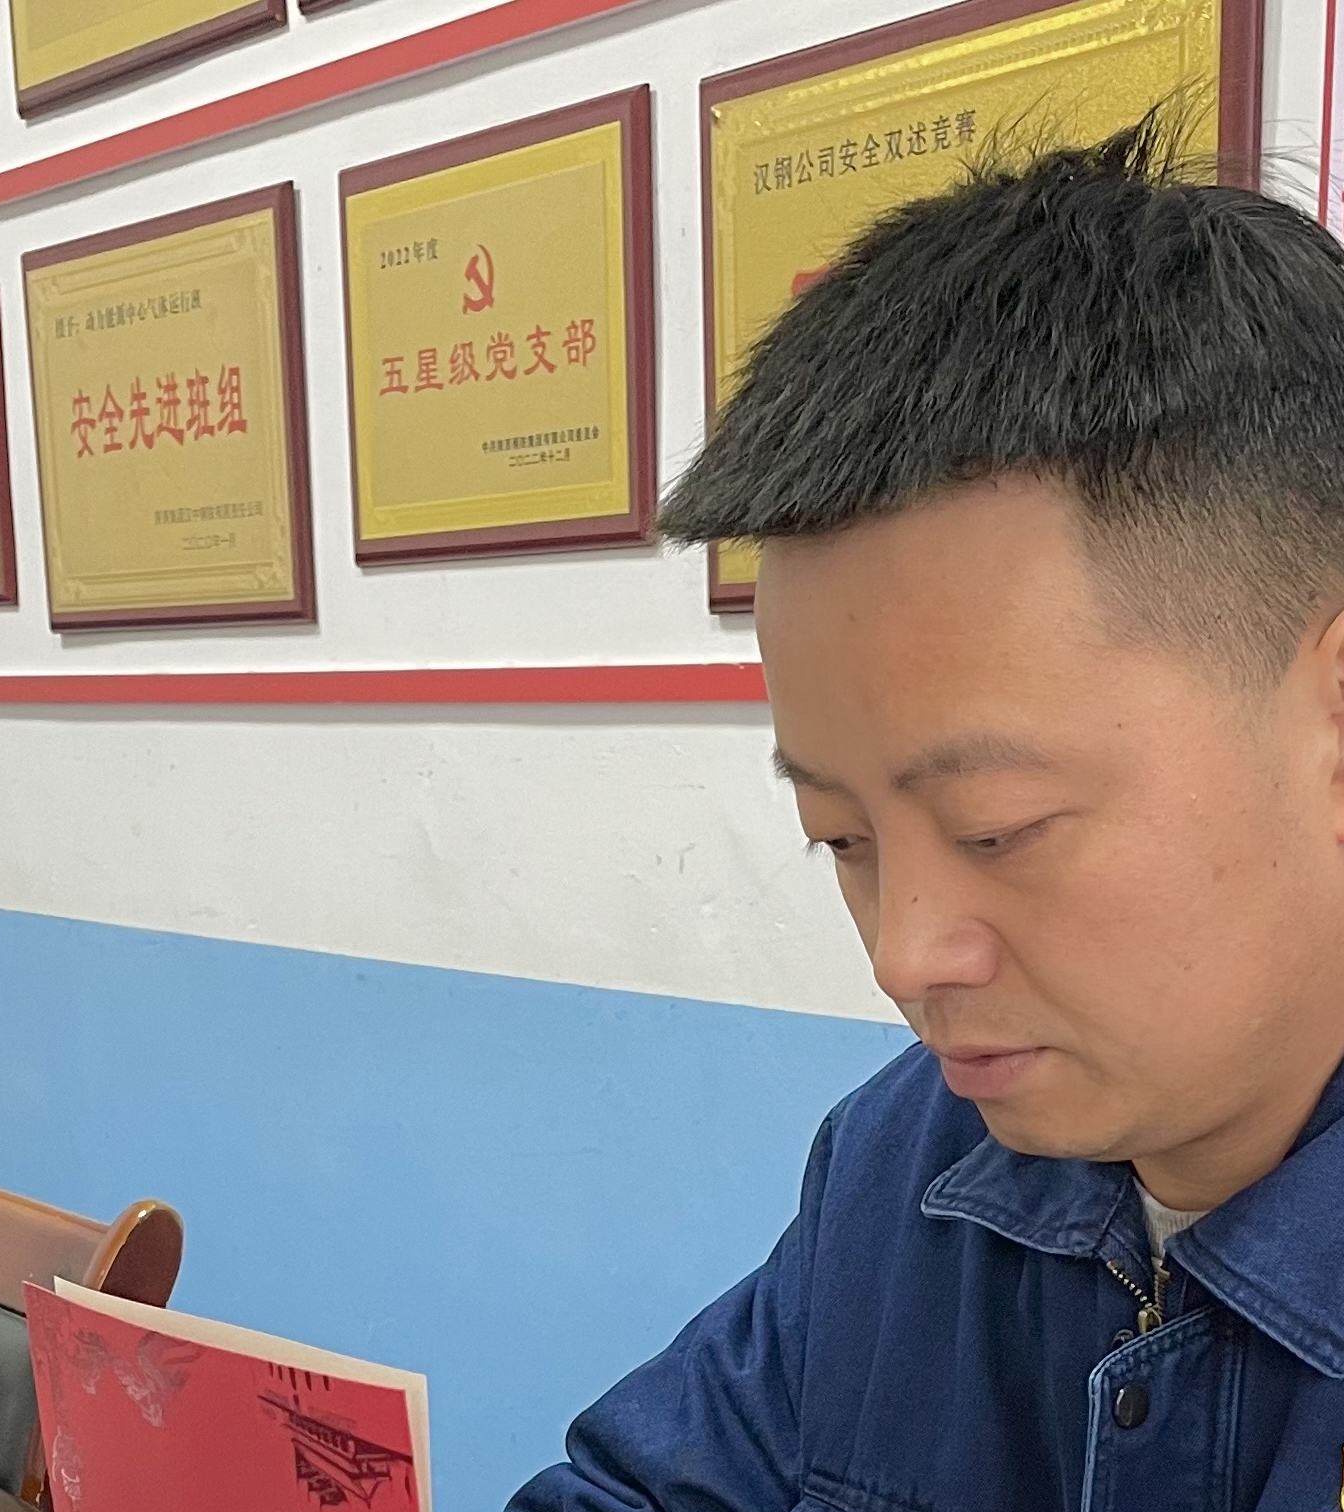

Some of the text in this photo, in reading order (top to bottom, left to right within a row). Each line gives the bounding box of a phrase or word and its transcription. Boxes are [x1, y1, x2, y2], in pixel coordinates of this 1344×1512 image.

[753, 109, 976, 195] 汉钢公司安全双述竞赛
[380, 237, 439, 270] 2022年度
[379, 318, 597, 397] 五星级党支部
[71, 361, 248, 459] 安全先进班组
